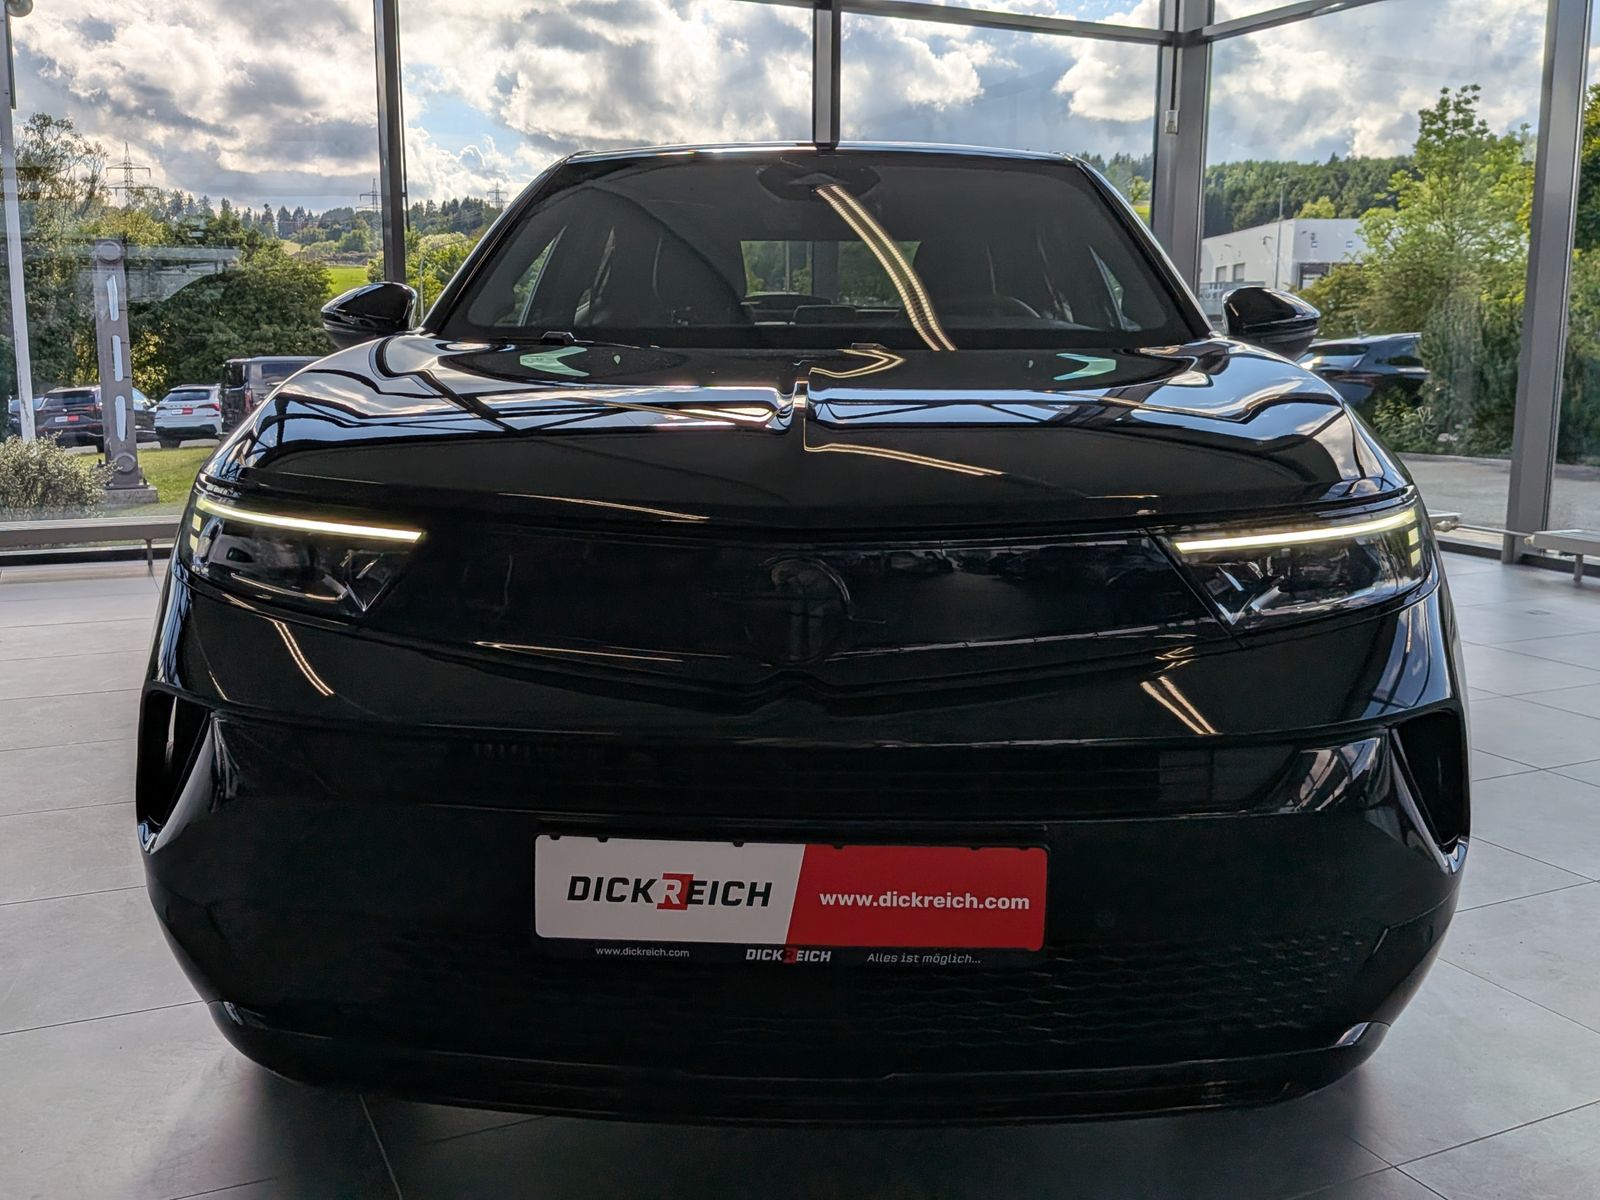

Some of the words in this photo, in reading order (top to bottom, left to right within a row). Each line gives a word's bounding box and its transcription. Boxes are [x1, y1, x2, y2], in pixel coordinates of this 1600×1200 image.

[567, 874, 772, 908] DICKREICH
[819, 891, 1030, 910] www.dickreich.com
[595, 947, 690, 958] www.dickreich.com
[745, 948, 831, 963] DICKREICH
[866, 953, 898, 963] Alles
[901, 953, 919, 963] ist
[922, 953, 981, 966] möglich...
